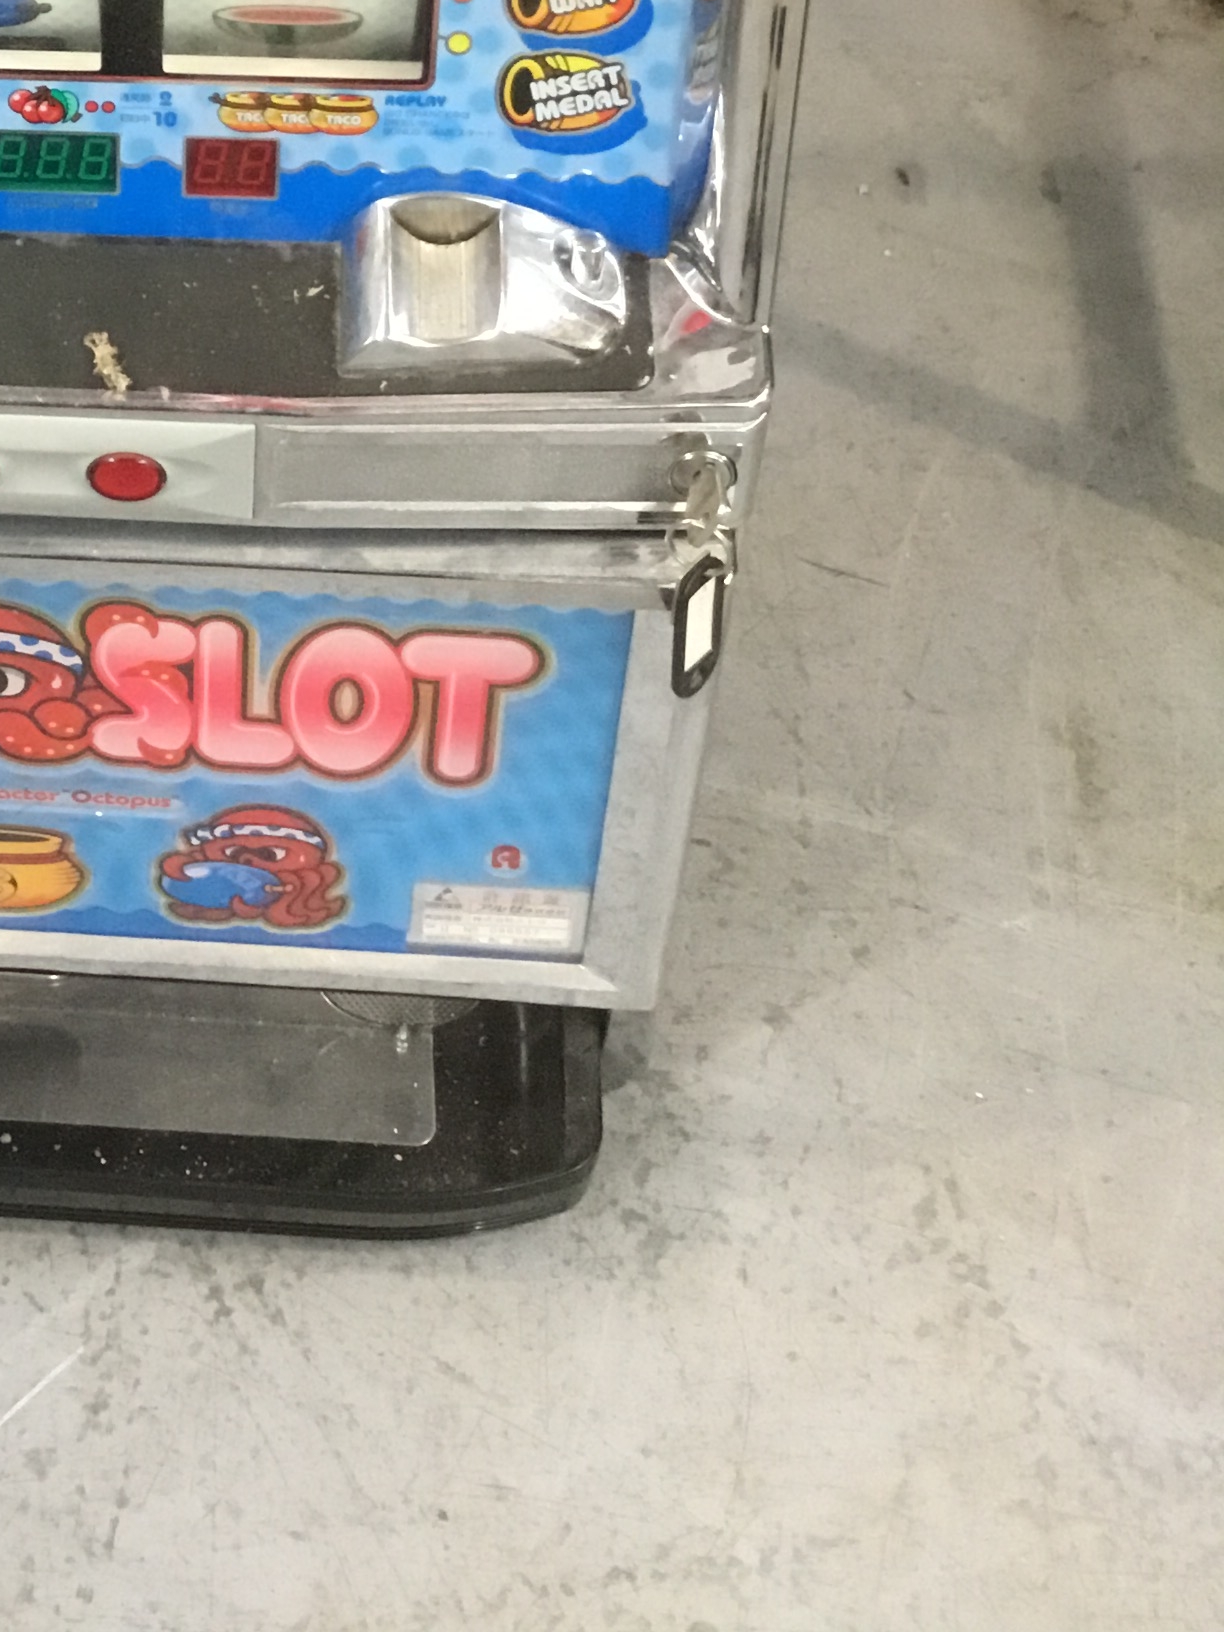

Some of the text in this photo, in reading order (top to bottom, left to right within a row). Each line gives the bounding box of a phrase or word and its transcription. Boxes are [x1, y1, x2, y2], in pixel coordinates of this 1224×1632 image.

[530, 65, 622, 100] INSERT
[384, 94, 447, 107] REPLAY
[534, 88, 629, 123] MEDAL
[153, 111, 177, 127] 10
[236, 111, 263, 124] TAC
[281, 113, 309, 125] TAC
[326, 114, 362, 126] TACO
[86, 608, 547, 788] SLOT
